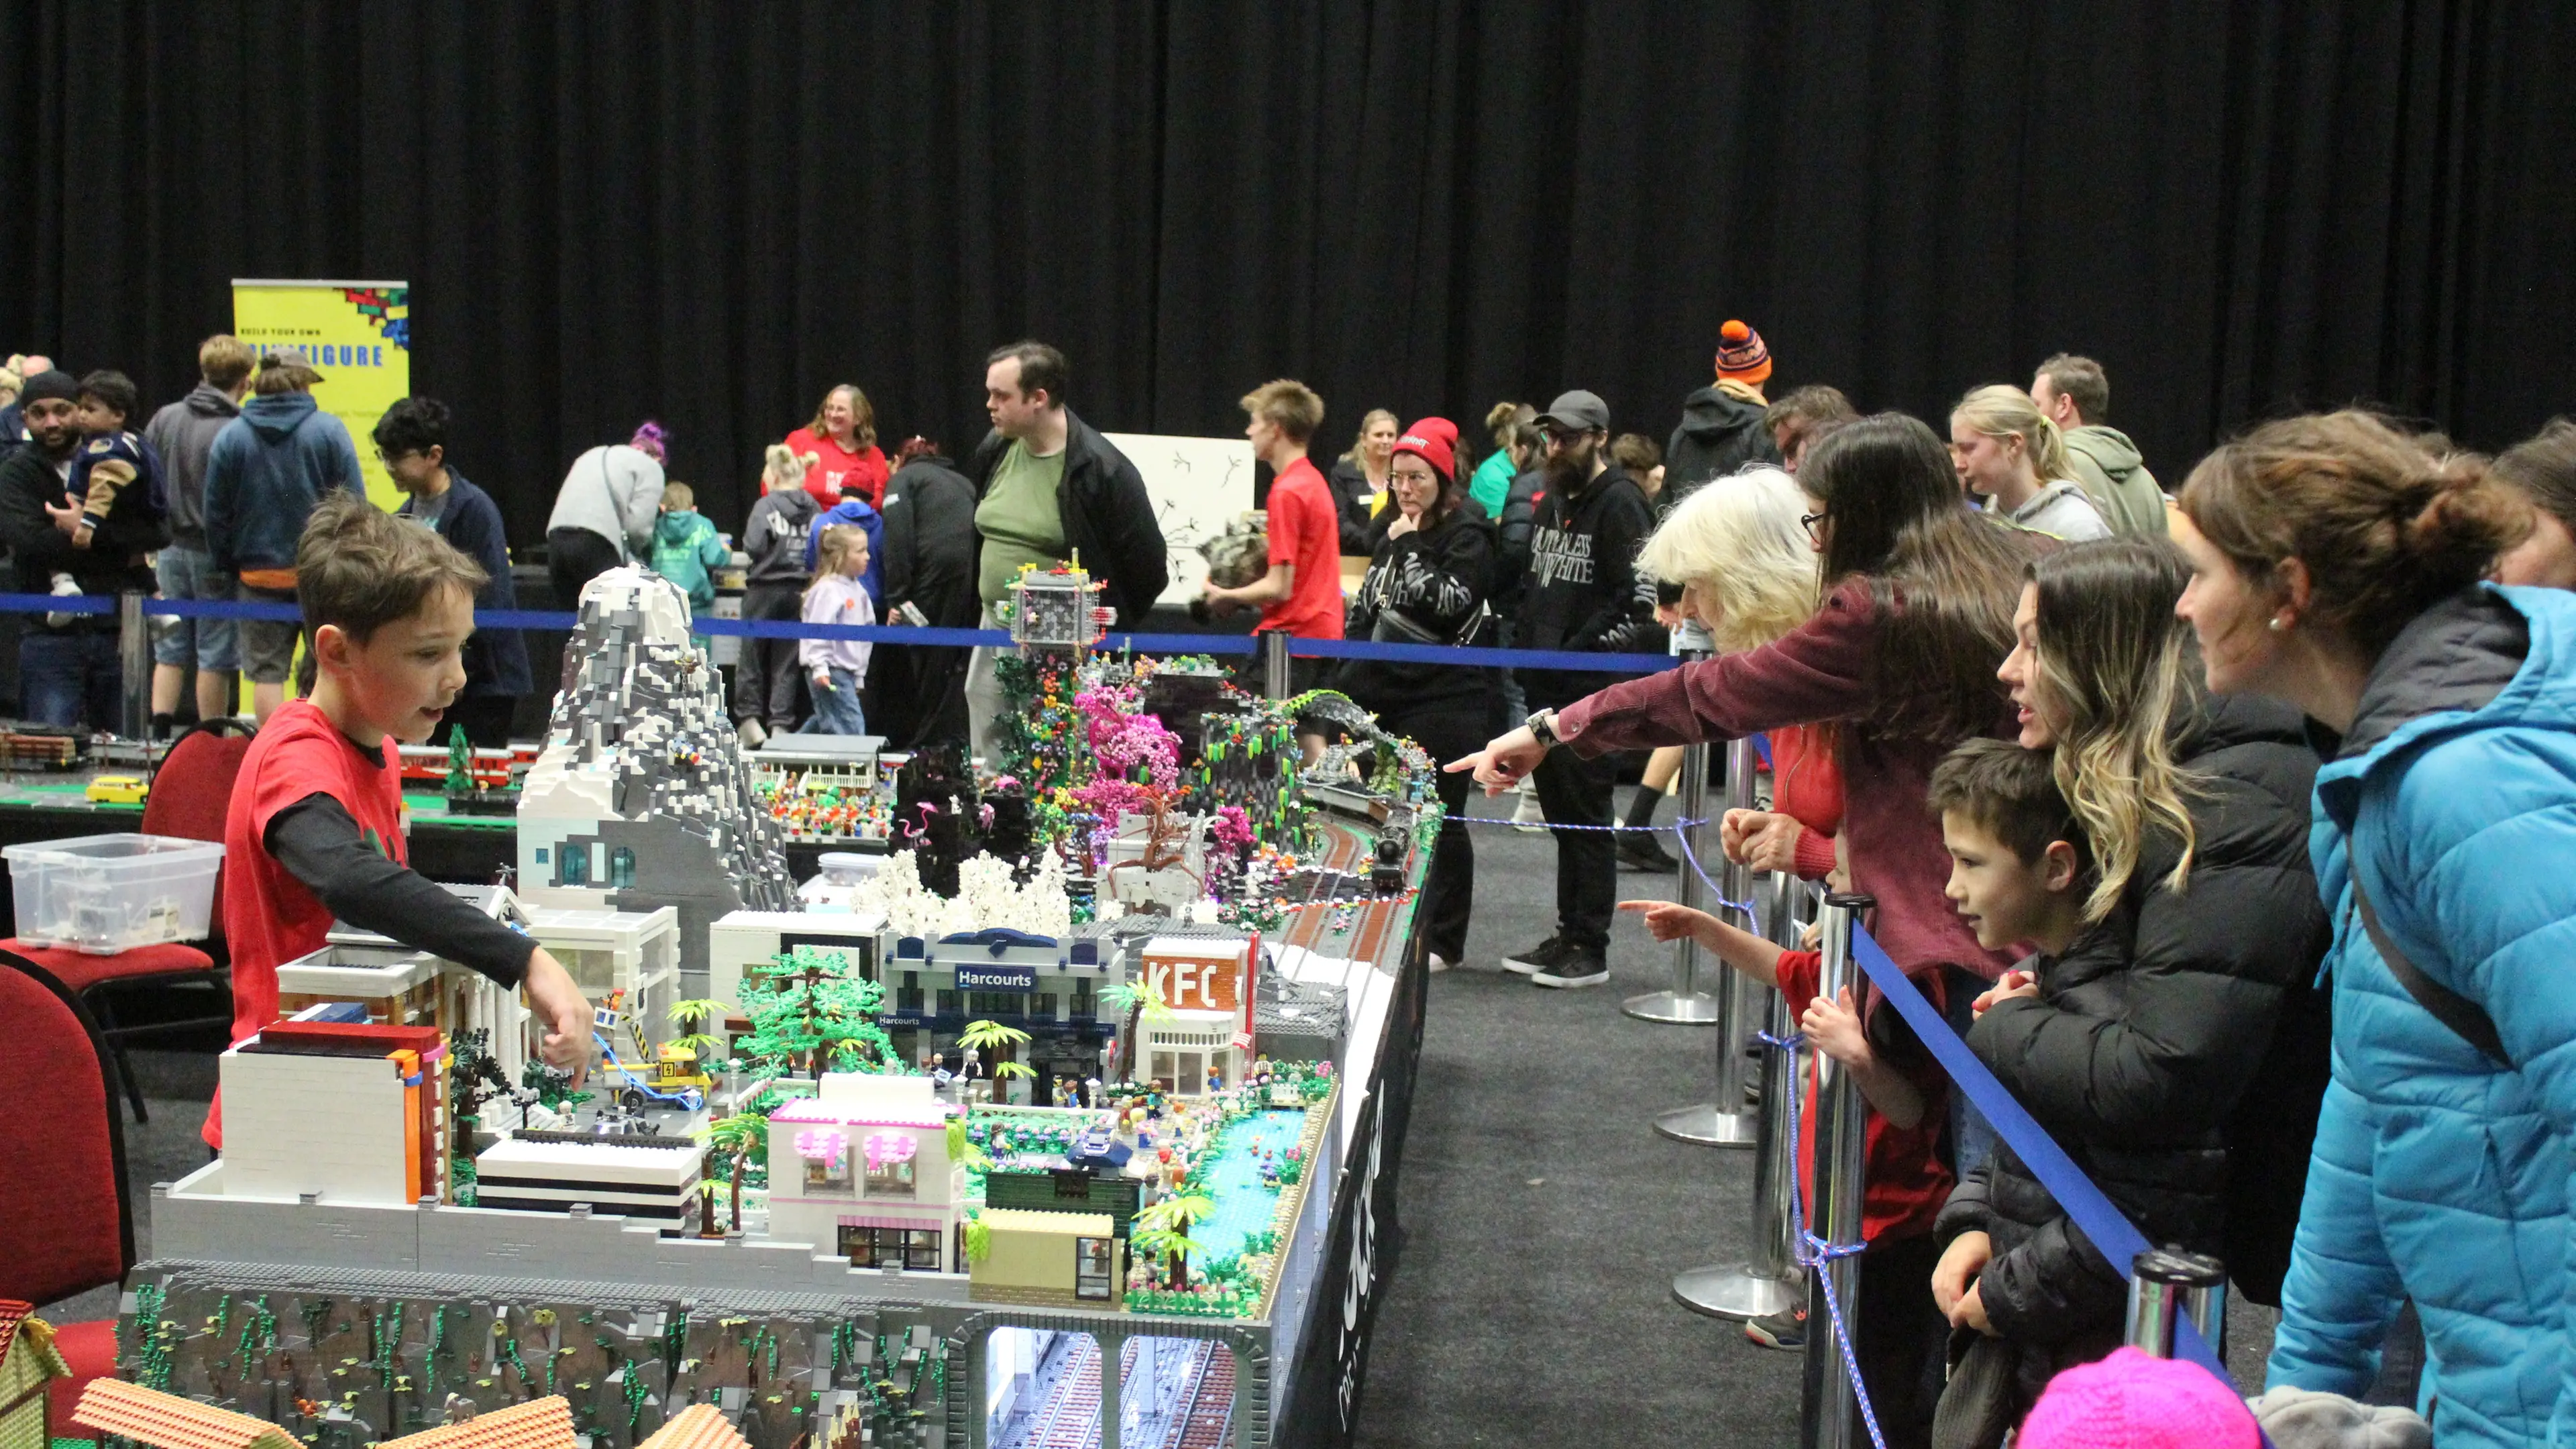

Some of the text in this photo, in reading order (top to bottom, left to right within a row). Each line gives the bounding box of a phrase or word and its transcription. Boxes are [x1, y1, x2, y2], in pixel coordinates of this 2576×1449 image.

[248, 343, 382, 366] IFIGURE
[959, 971, 1032, 987] Harcourts
[1148, 962, 1217, 1008] KFC
[879, 1016, 920, 1025] Harcourts
[433, 1058, 445, 1200] LIBRAR
